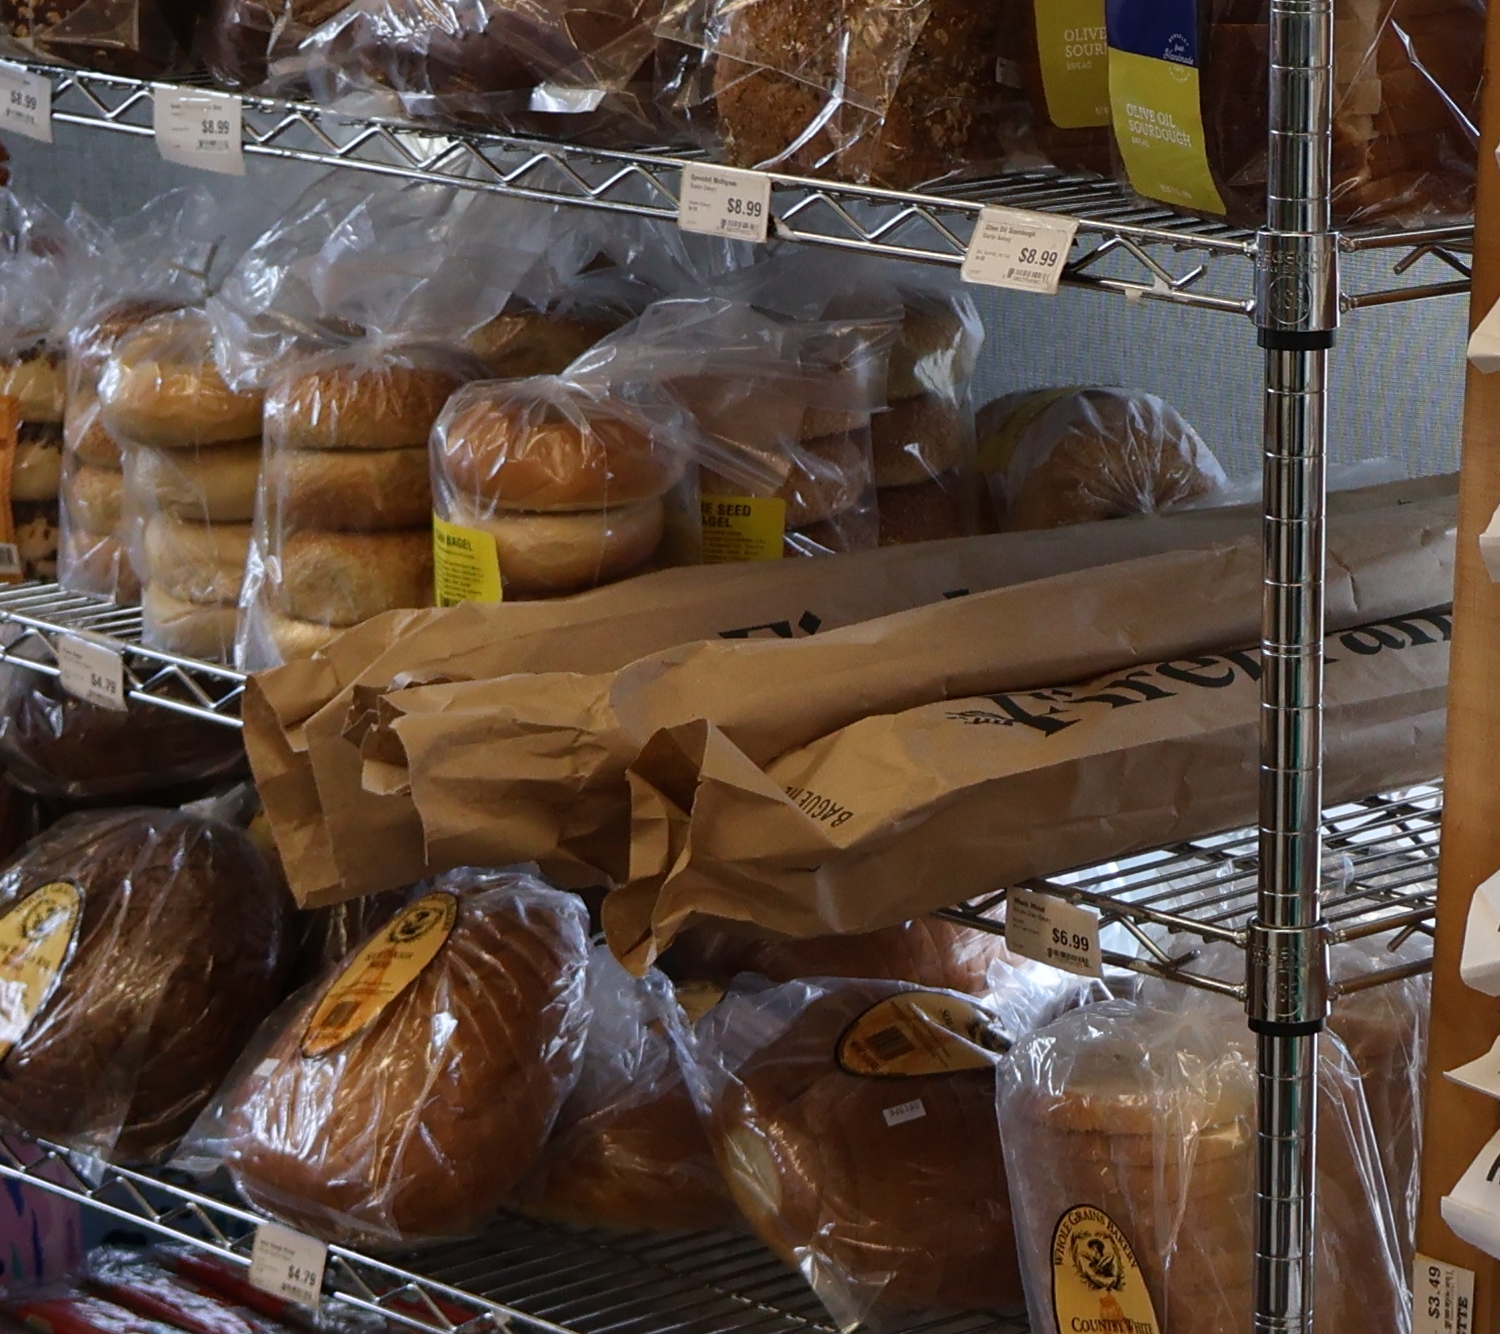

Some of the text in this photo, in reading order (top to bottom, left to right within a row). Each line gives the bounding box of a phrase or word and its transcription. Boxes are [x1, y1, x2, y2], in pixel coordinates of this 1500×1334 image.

[1126, 102, 1177, 128] OLIVE OIL
[1128, 120, 1192, 149] SOURDOUGH
[727, 197, 762, 218] $8.99
[1017, 246, 1058, 269] $8.99
[1051, 922, 1091, 954] $6.99
[1427, 1265, 1442, 1319] $3.49
[1071, 1317, 1124, 1333] COUNTRY
